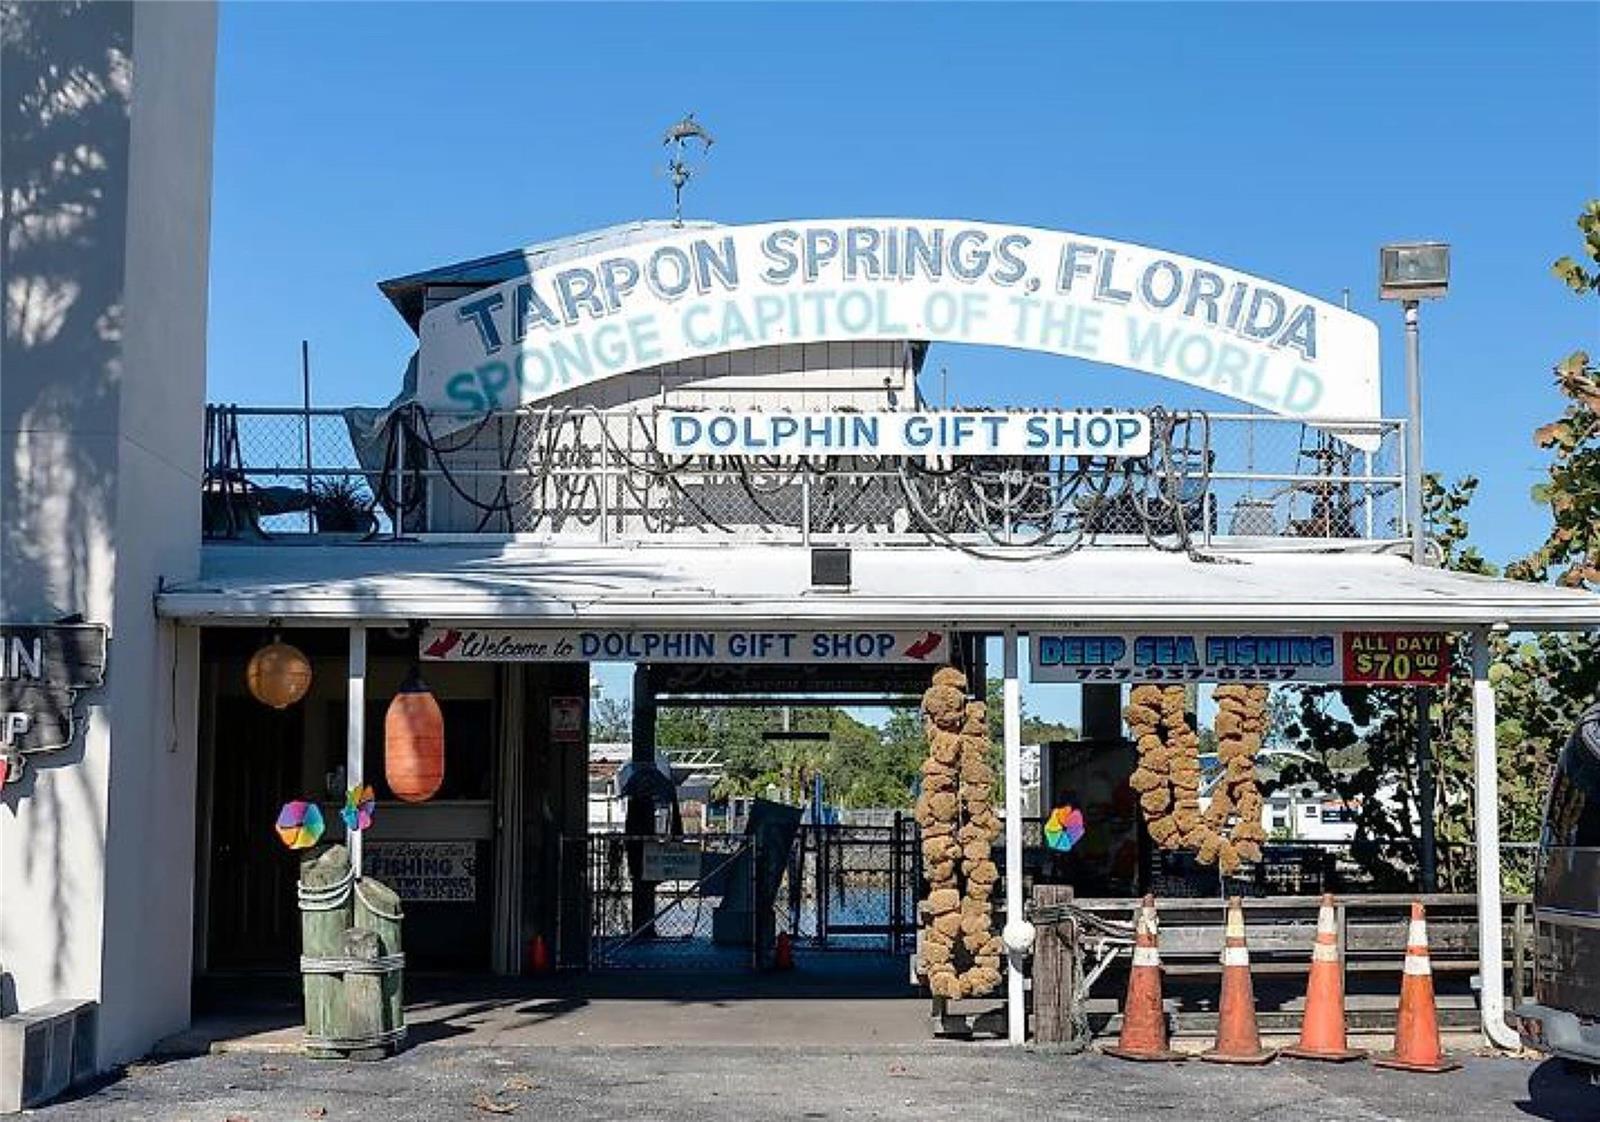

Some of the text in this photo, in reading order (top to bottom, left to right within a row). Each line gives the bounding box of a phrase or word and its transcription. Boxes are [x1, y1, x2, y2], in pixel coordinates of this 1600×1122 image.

[460, 226, 1319, 360] TARPON SPRINGS, FLORIDA
[444, 288, 1324, 420] SPONGE CAPITOL OF THE WORLD
[671, 416, 1141, 447] DOLPHIN GIFT SHOP
[460, 631, 896, 657] Welcome to DOLPHIN GIFT SHOP
[1040, 636, 1334, 666] DEEP SEA FISHING
[1351, 637, 1441, 651] ALL DAY!
